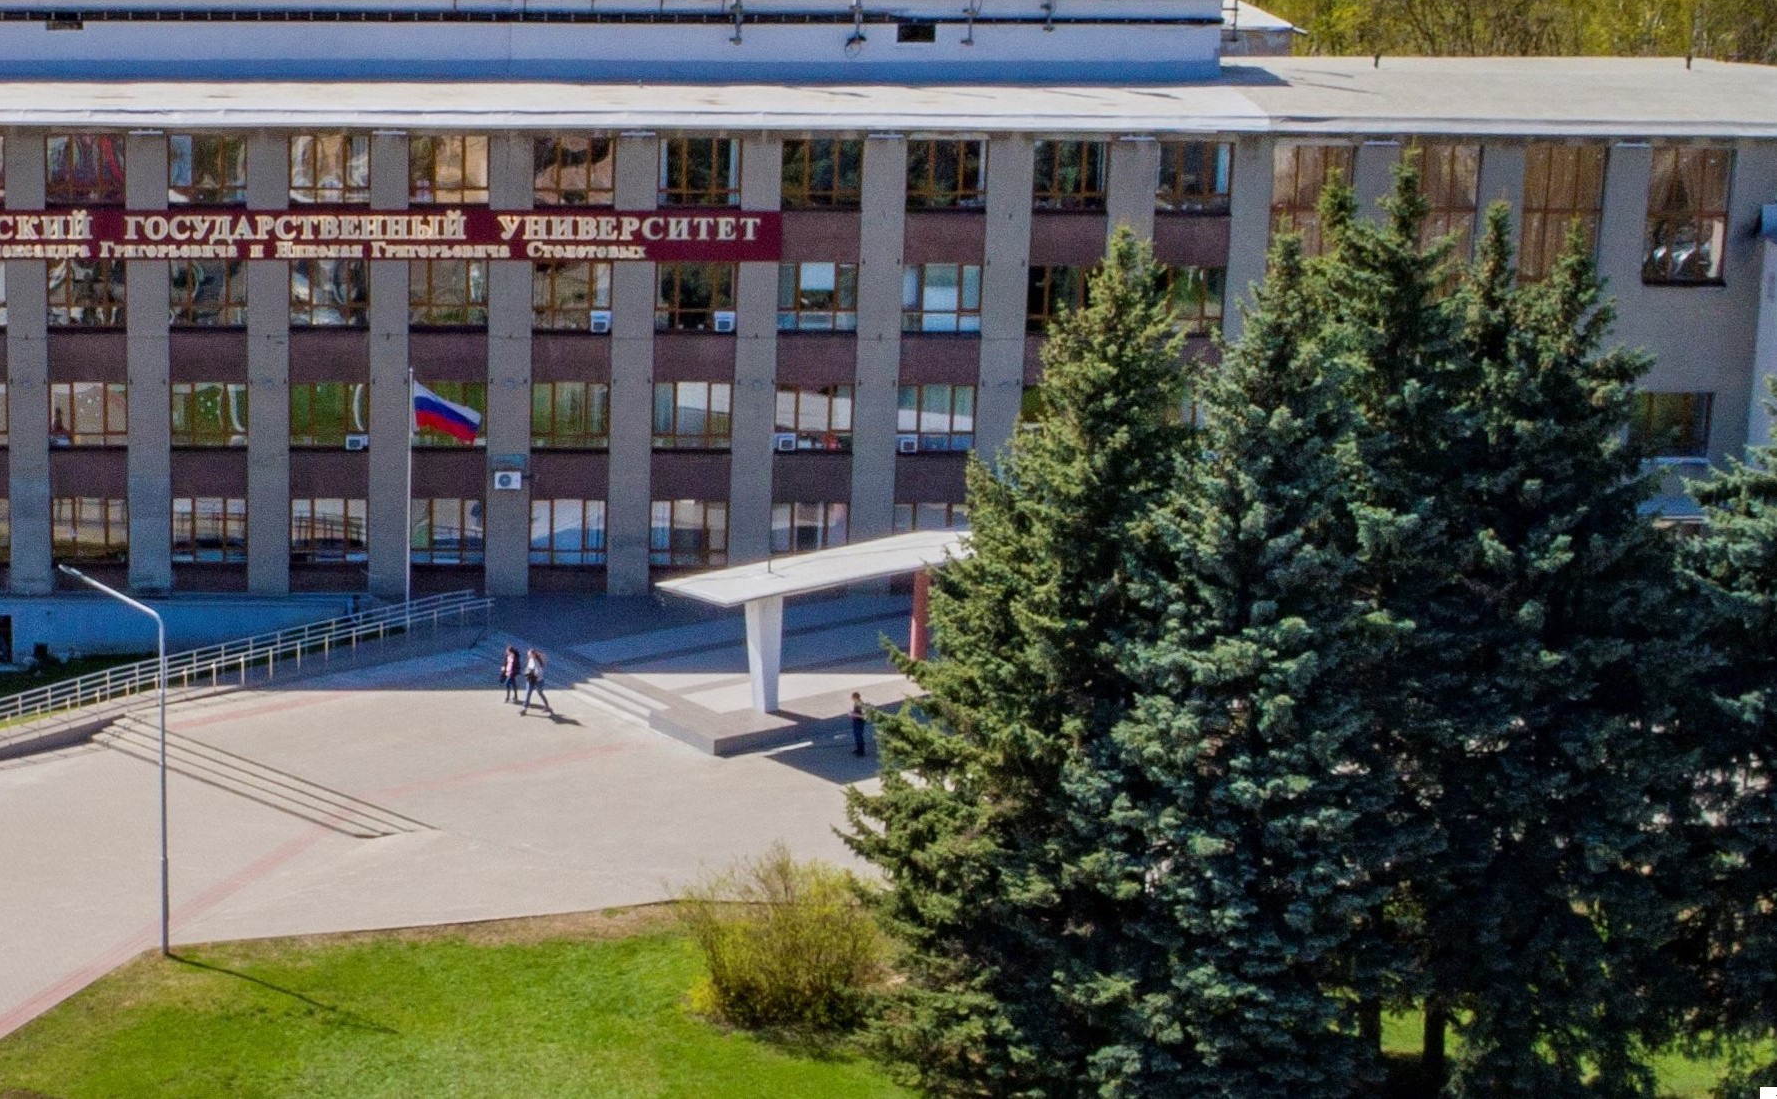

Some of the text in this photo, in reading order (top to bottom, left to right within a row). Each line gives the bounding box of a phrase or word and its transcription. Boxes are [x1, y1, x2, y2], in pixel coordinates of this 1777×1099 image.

[125, 210, 467, 243] ГОСУДАРСТВЕННЫЙ
[498, 216, 761, 240] УНИВЕРСИТЕТ
[100, 242, 237, 258] Григорьевича
[250, 244, 264, 258] и
[275, 242, 363, 258] Николая
[371, 242, 511, 258] Григорьевича
[526, 242, 647, 258] Столетовых
